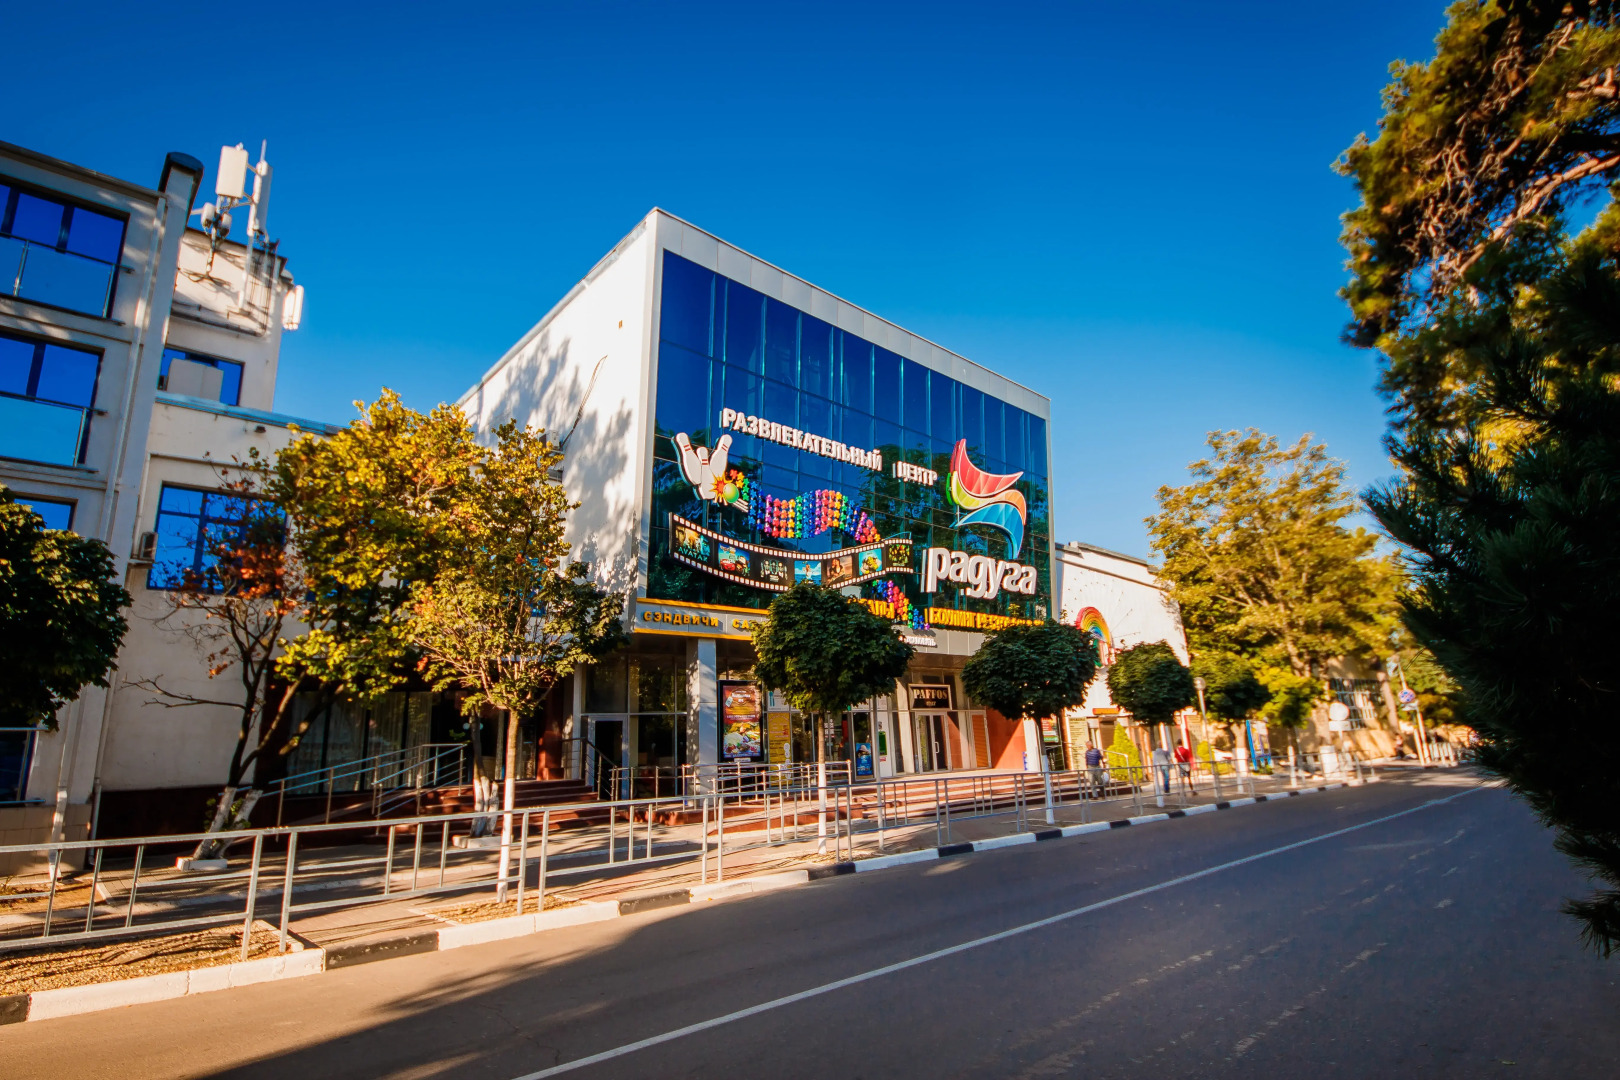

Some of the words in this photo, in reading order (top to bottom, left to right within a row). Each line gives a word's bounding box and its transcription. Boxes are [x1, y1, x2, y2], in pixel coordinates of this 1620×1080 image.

[722, 407, 882, 471] РАЗВЛЕКАТЕЛЬНЫЙ
[897, 461, 938, 486] ЦЕНТР
[643, 611, 719, 627] СЭНДВИЧИ
[732, 618, 751, 629] СА
[929, 607, 976, 628] БОУЛИНГ
[913, 688, 948, 699] PAFFOS
